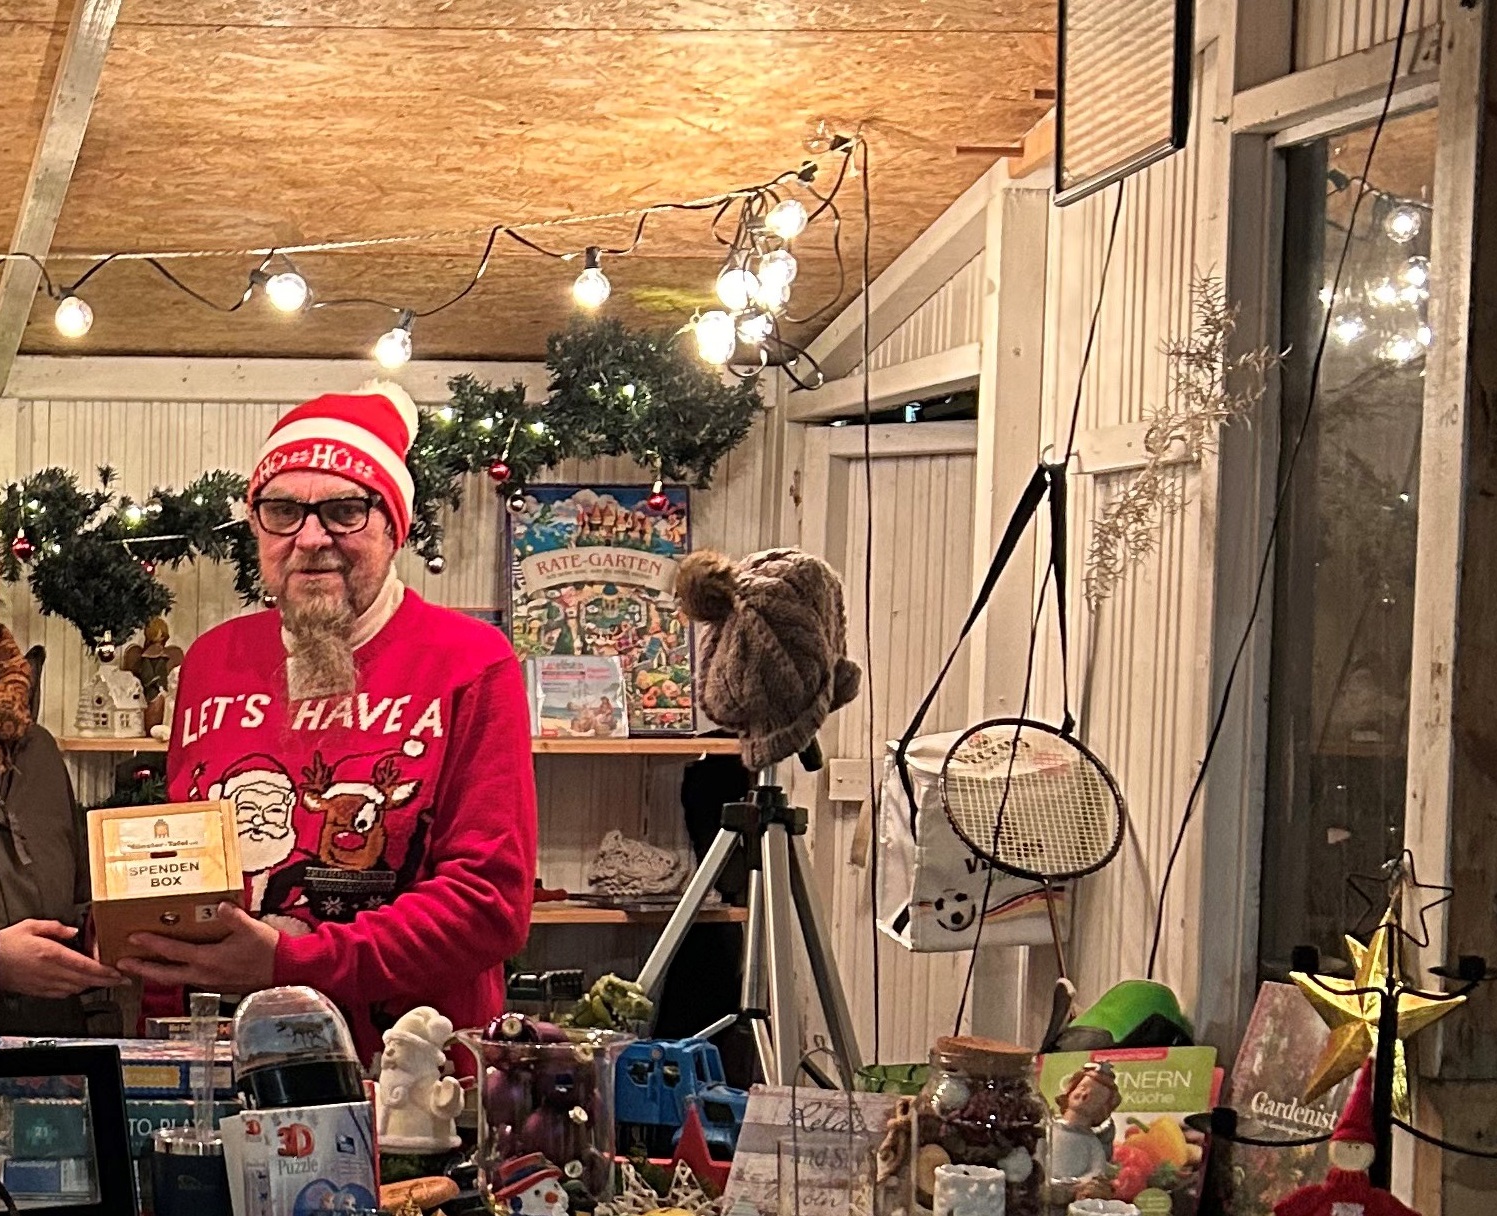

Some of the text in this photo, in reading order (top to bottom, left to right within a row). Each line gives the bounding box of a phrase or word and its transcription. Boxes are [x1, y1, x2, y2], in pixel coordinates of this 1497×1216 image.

[308, 443, 353, 472] HO
[535, 552, 663, 577] RATE-GARTEN
[182, 693, 444, 748] LET'S HAVE A
[129, 861, 200, 877] SPENDEN
[150, 876, 182, 888] BOX
[1251, 1091, 1339, 1131] Gardenist
[277, 1123, 315, 1158] 3D
[278, 1158, 319, 1175] Puzzle
